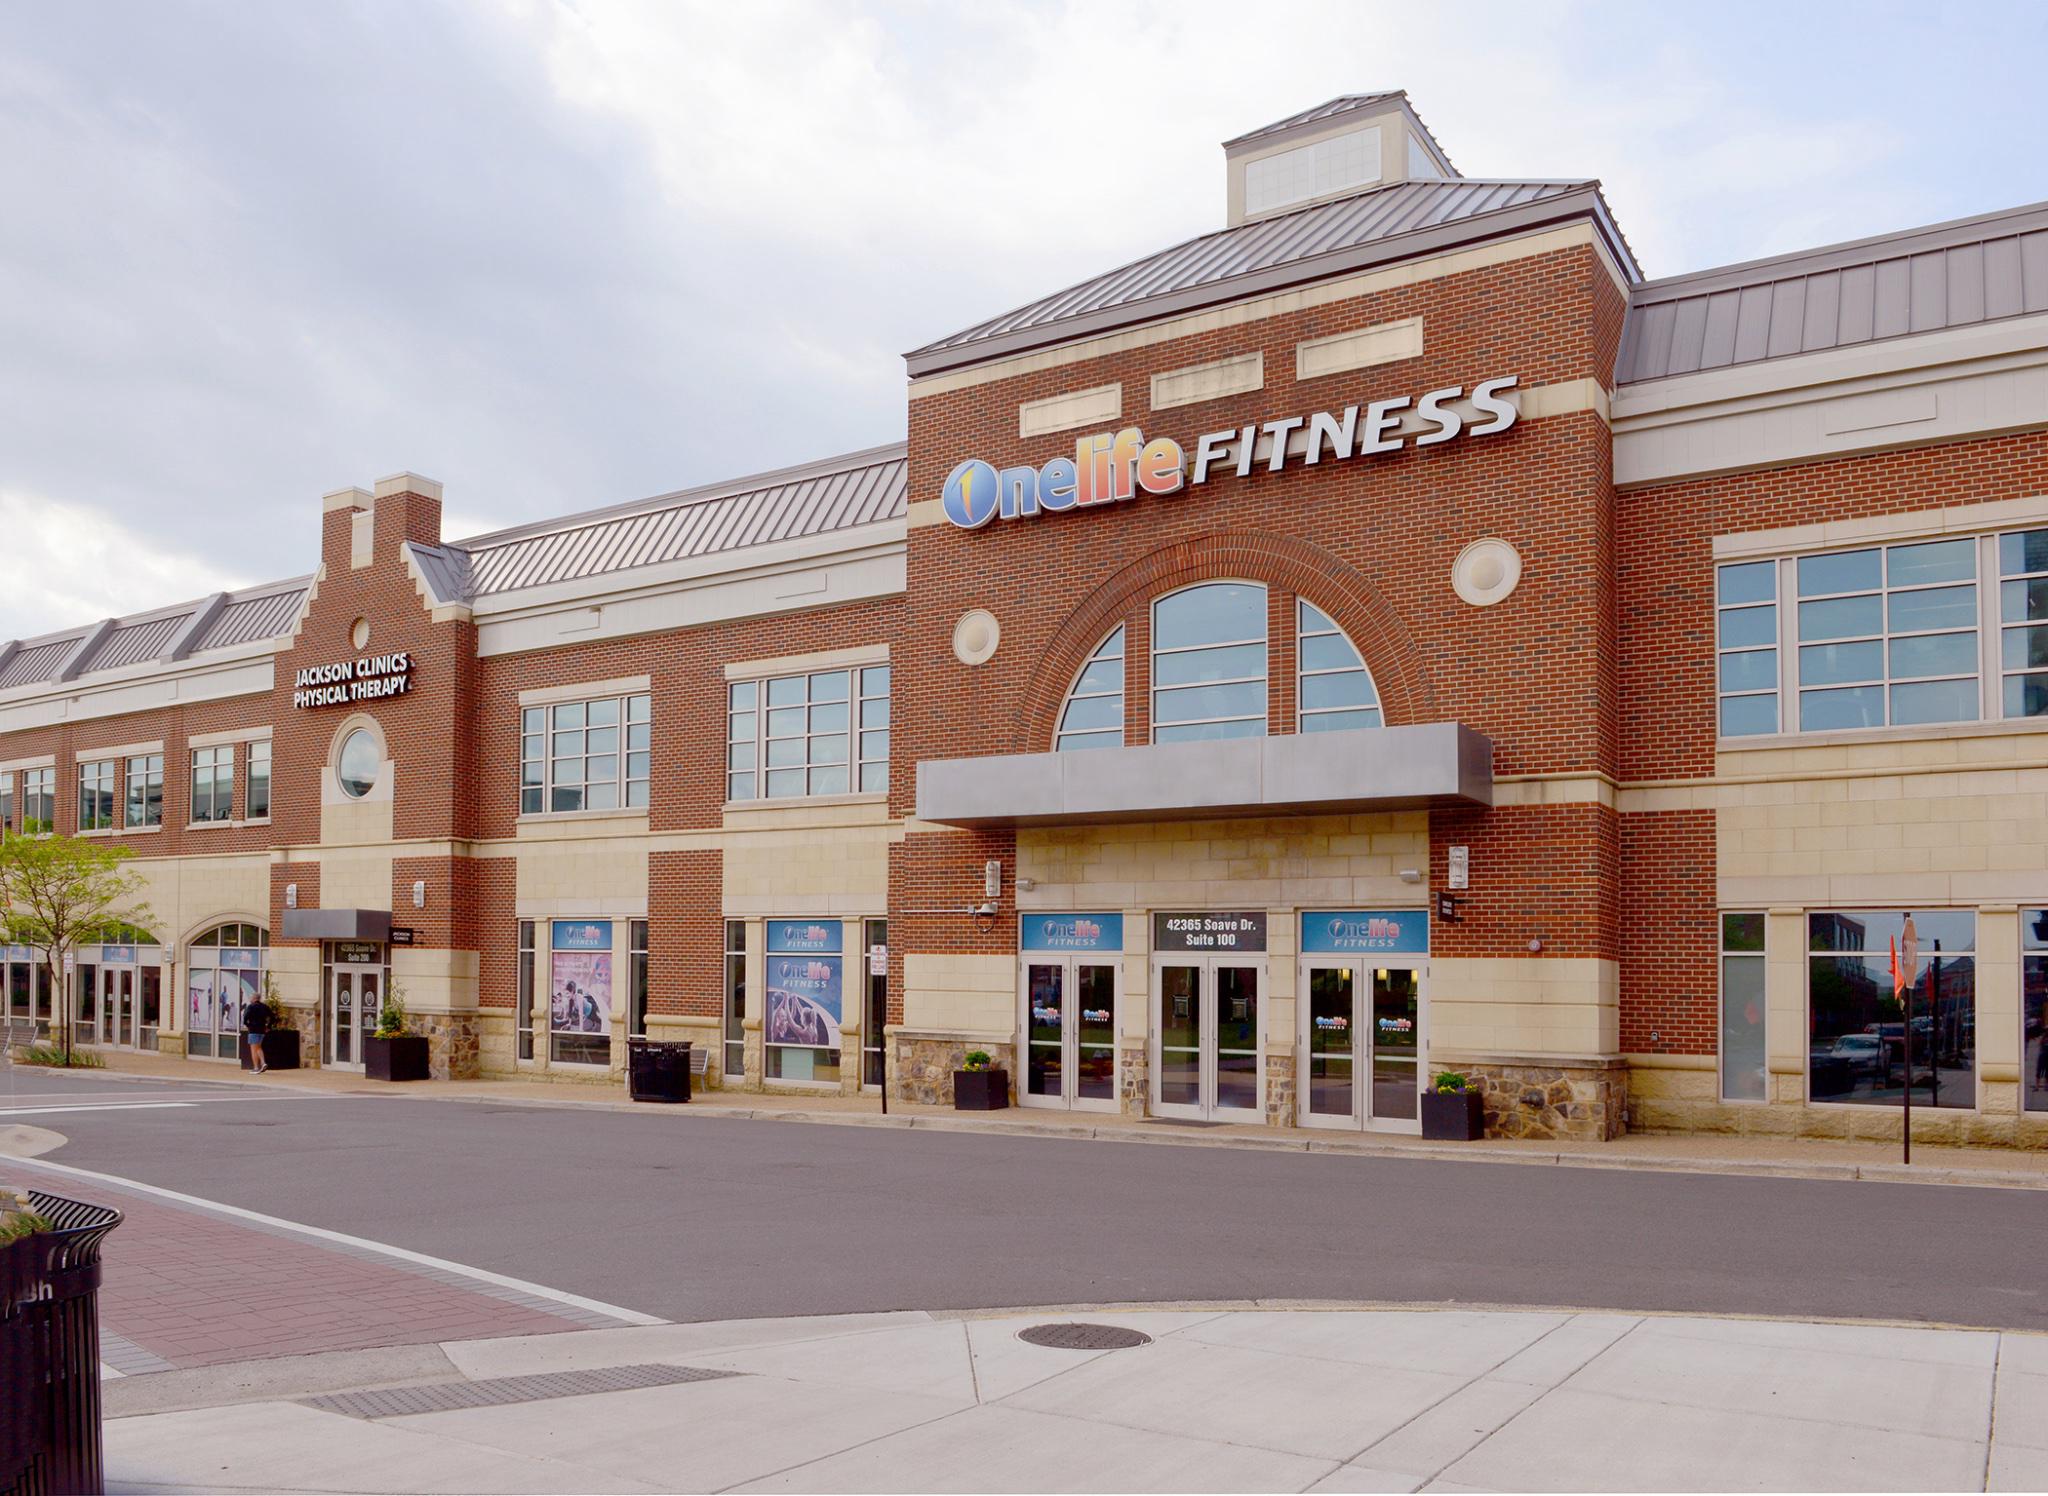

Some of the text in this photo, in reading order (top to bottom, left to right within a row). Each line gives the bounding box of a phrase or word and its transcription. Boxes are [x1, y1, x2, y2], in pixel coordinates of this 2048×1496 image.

[941, 375, 1519, 529] Onelife FITNESS
[294, 652, 409, 687] JACKSON CLINICS
[294, 675, 408, 708] PHYSICAL THERAPY
[1042, 920, 1101, 938] Onelife
[1166, 918, 1256, 931] 42365 Soave Dr.
[1328, 918, 1400, 938] Onelife
[786, 940, 824, 948] FITNESS
[1047, 938, 1097, 946] FITNESS
[1186, 933, 1236, 946] Suite 100
[1334, 938, 1395, 947] FITNESS
[782, 979, 828, 989] FITNESS
